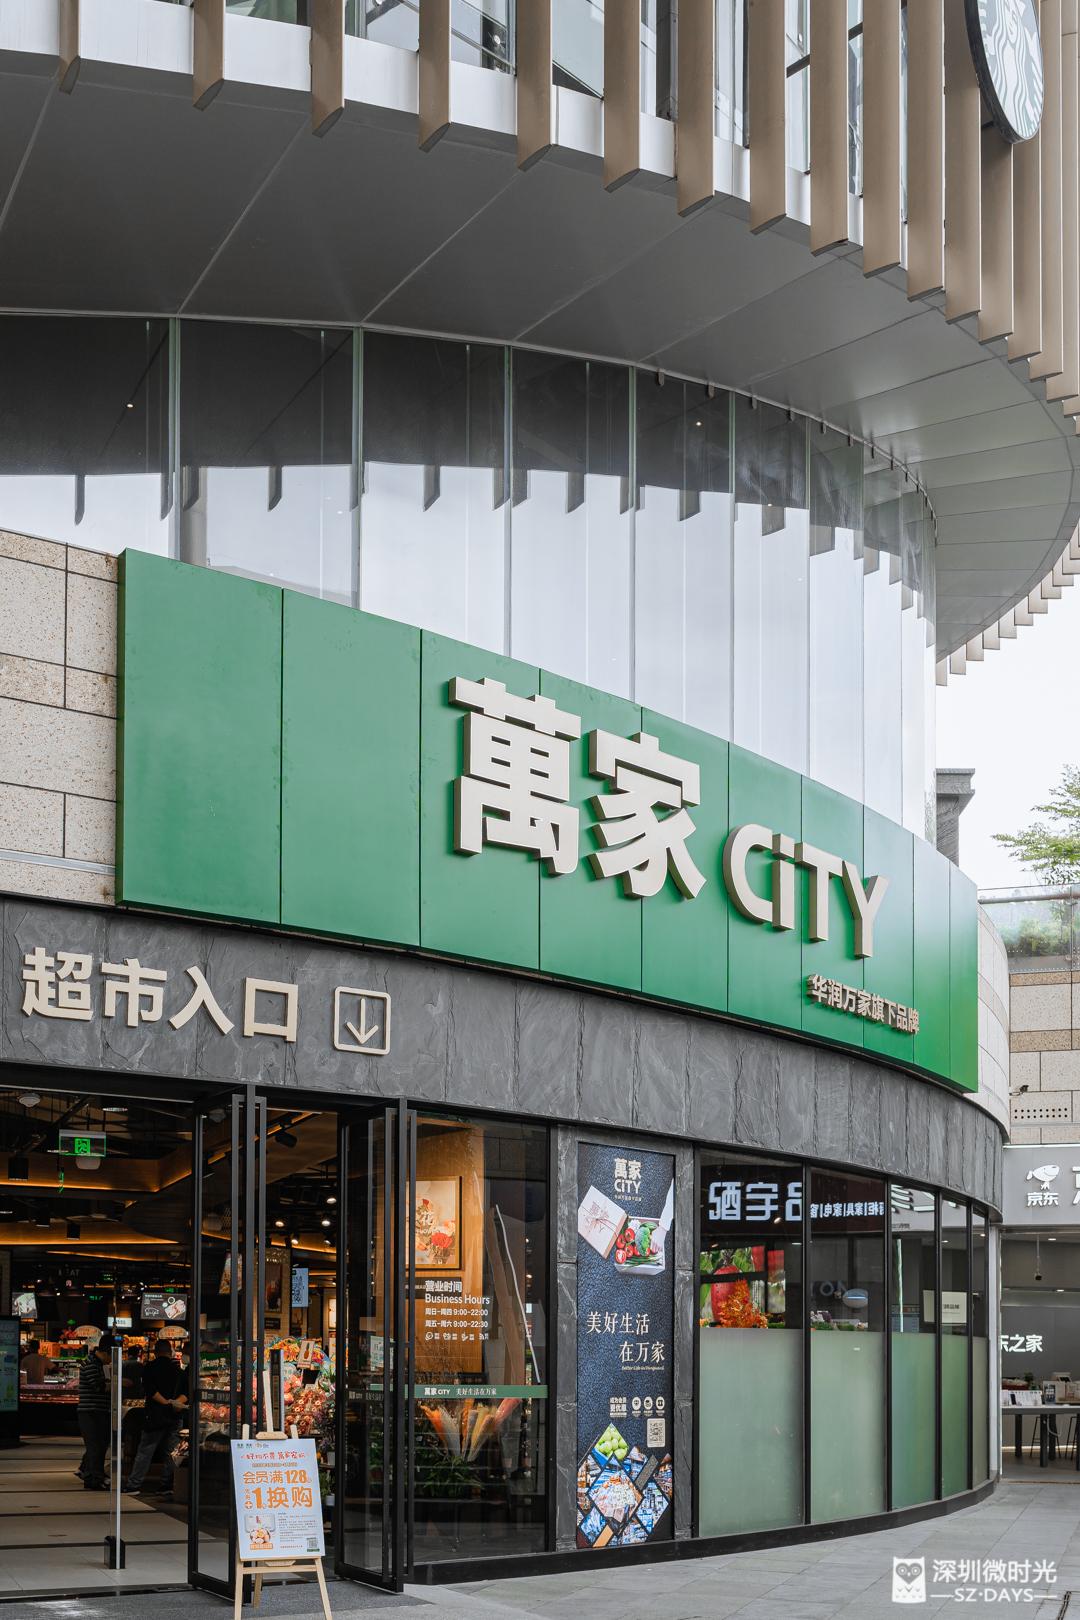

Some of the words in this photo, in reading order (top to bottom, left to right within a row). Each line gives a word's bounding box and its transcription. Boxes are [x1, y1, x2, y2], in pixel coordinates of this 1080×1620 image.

[449, 676, 706, 899] 萬家
[22, 947, 298, 1042] 超市入口
[806, 974, 920, 1034] 华润万家旗下品牌
[1027, 1192, 1059, 1207] 京东
[425, 1280, 462, 1292] 营业时间
[425, 1294, 462, 1304] Business
[464, 1295, 490, 1305] Hours
[587, 1311, 650, 1335] 美好生活
[619, 1341, 665, 1363] 在万家
